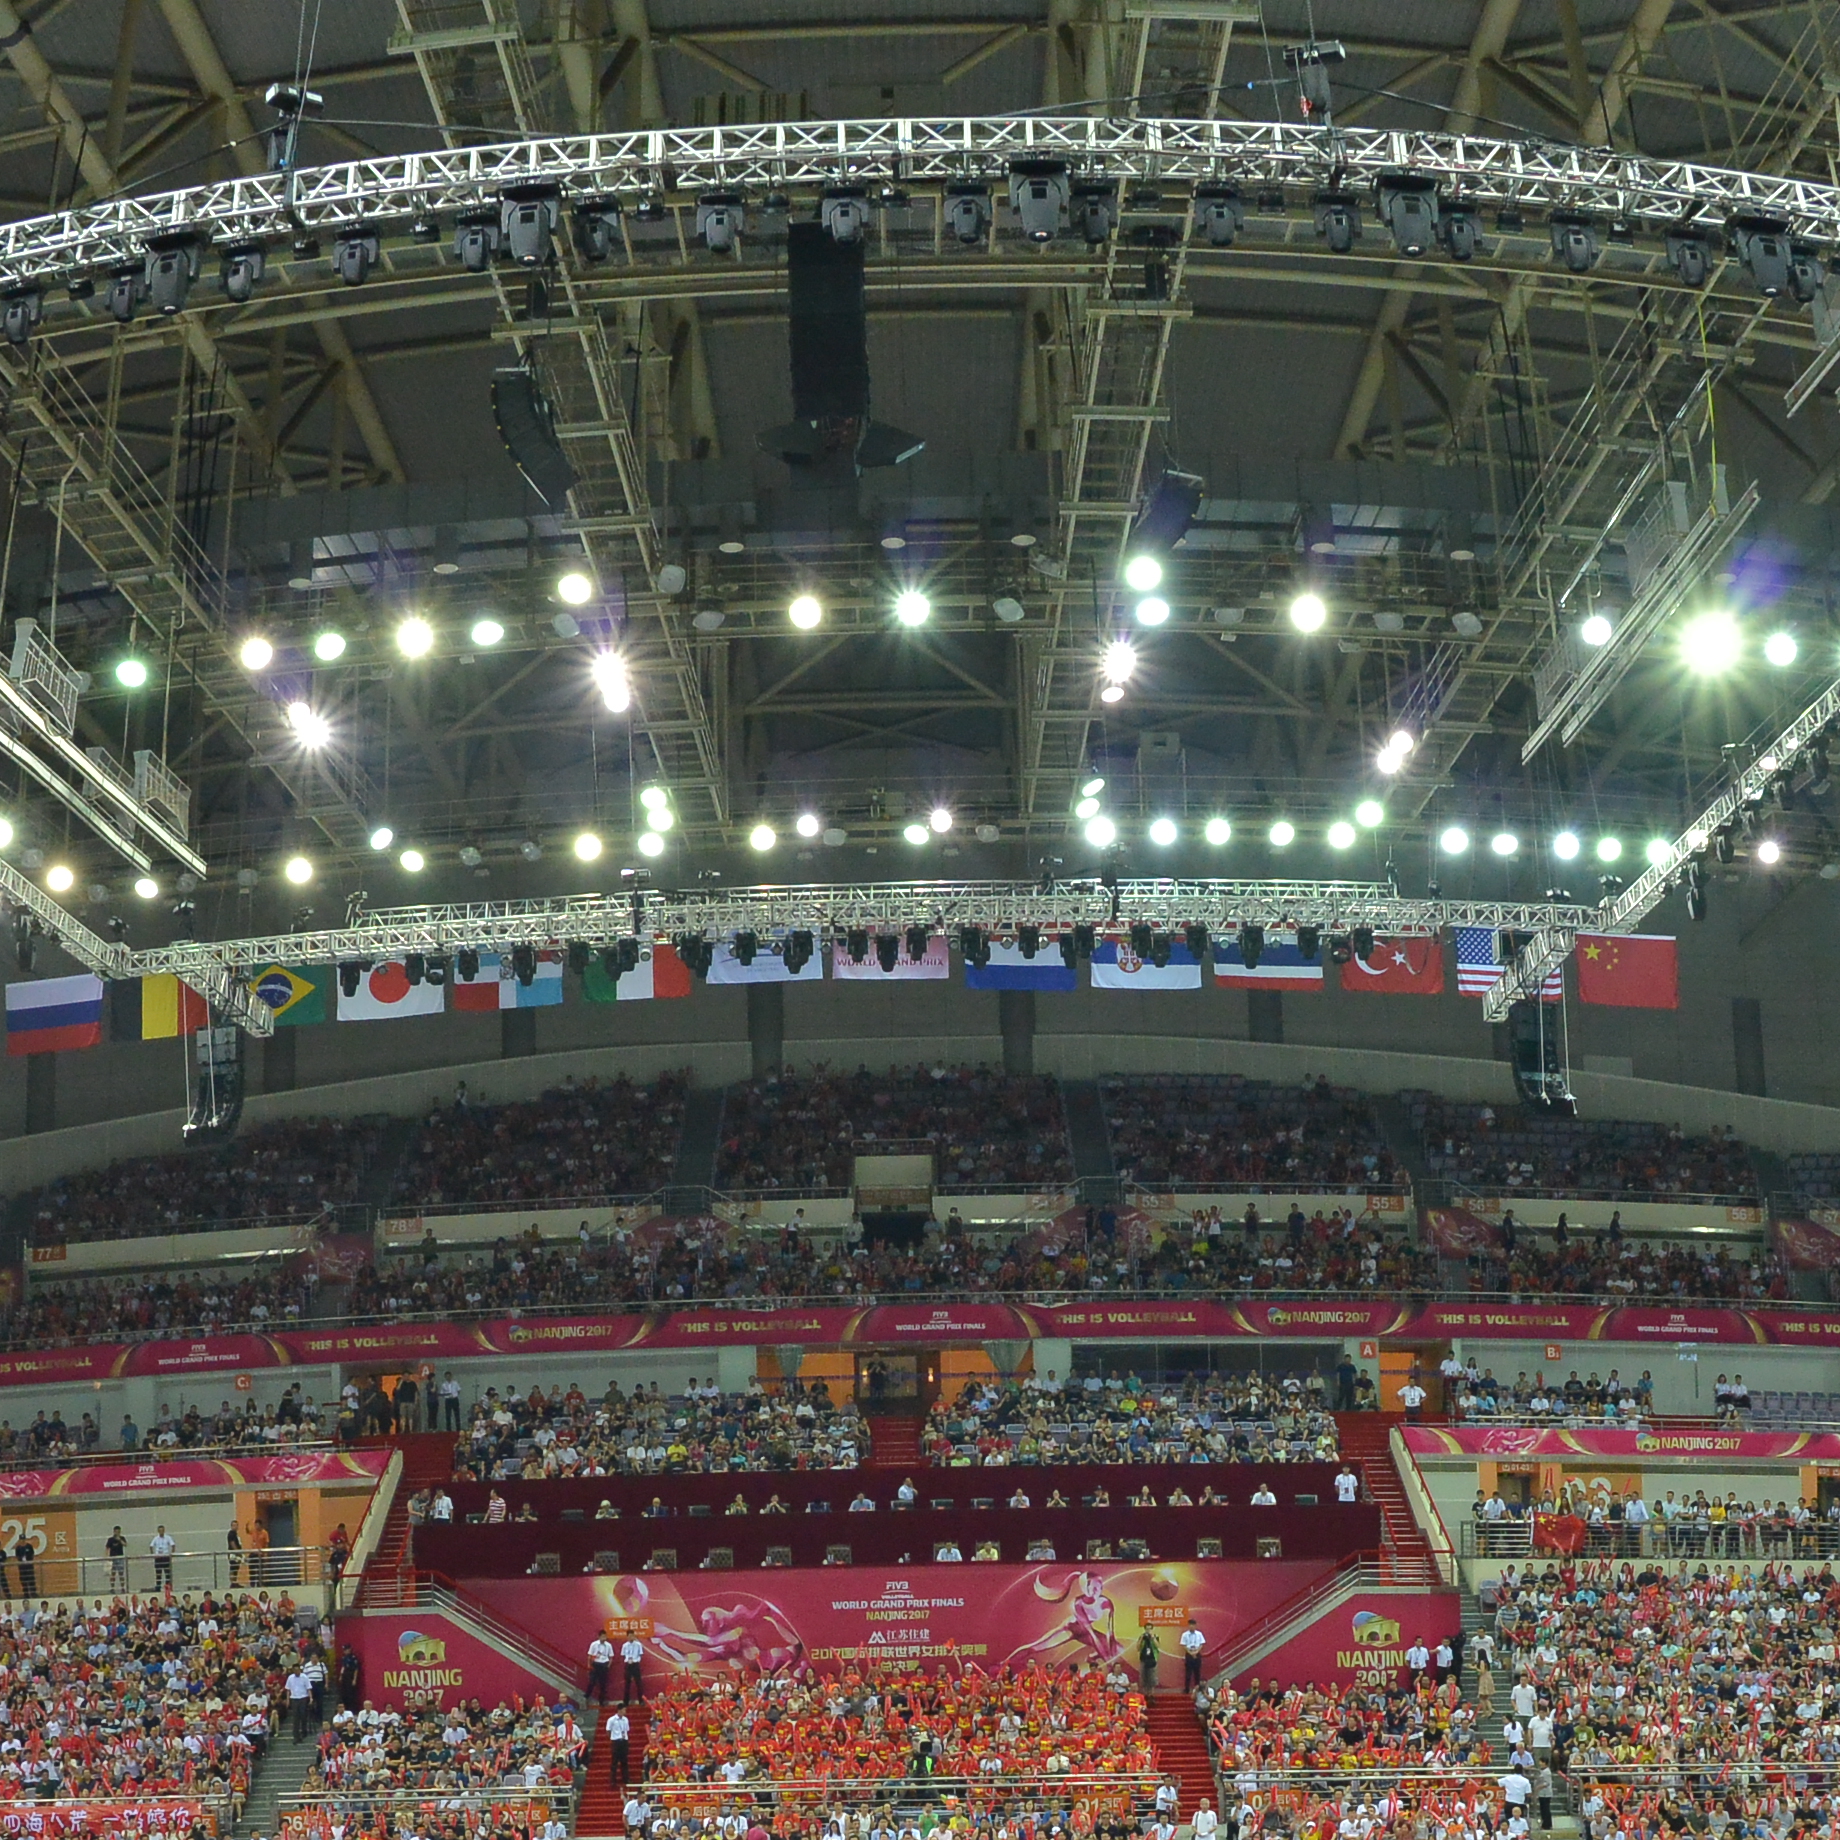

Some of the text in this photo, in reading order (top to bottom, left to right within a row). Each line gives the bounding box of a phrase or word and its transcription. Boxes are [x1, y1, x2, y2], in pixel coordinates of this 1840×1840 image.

[1, 1518, 47, 1557] 25
[886, 1582, 909, 1590] FIVB
[832, 1598, 964, 1609] WORLD GRAND PRIX FINALS
[866, 1610, 930, 1621] NANJING 2017
[1144, 1608, 1184, 1618] 主席台区
[610, 1620, 649, 1630] 主席台区
[887, 1629, 930, 1640] 江苏住建
[1337, 1650, 1408, 1668] NANJIN
[383, 1669, 462, 1688] NANJING
[1357, 1670, 1397, 1687] 2017
